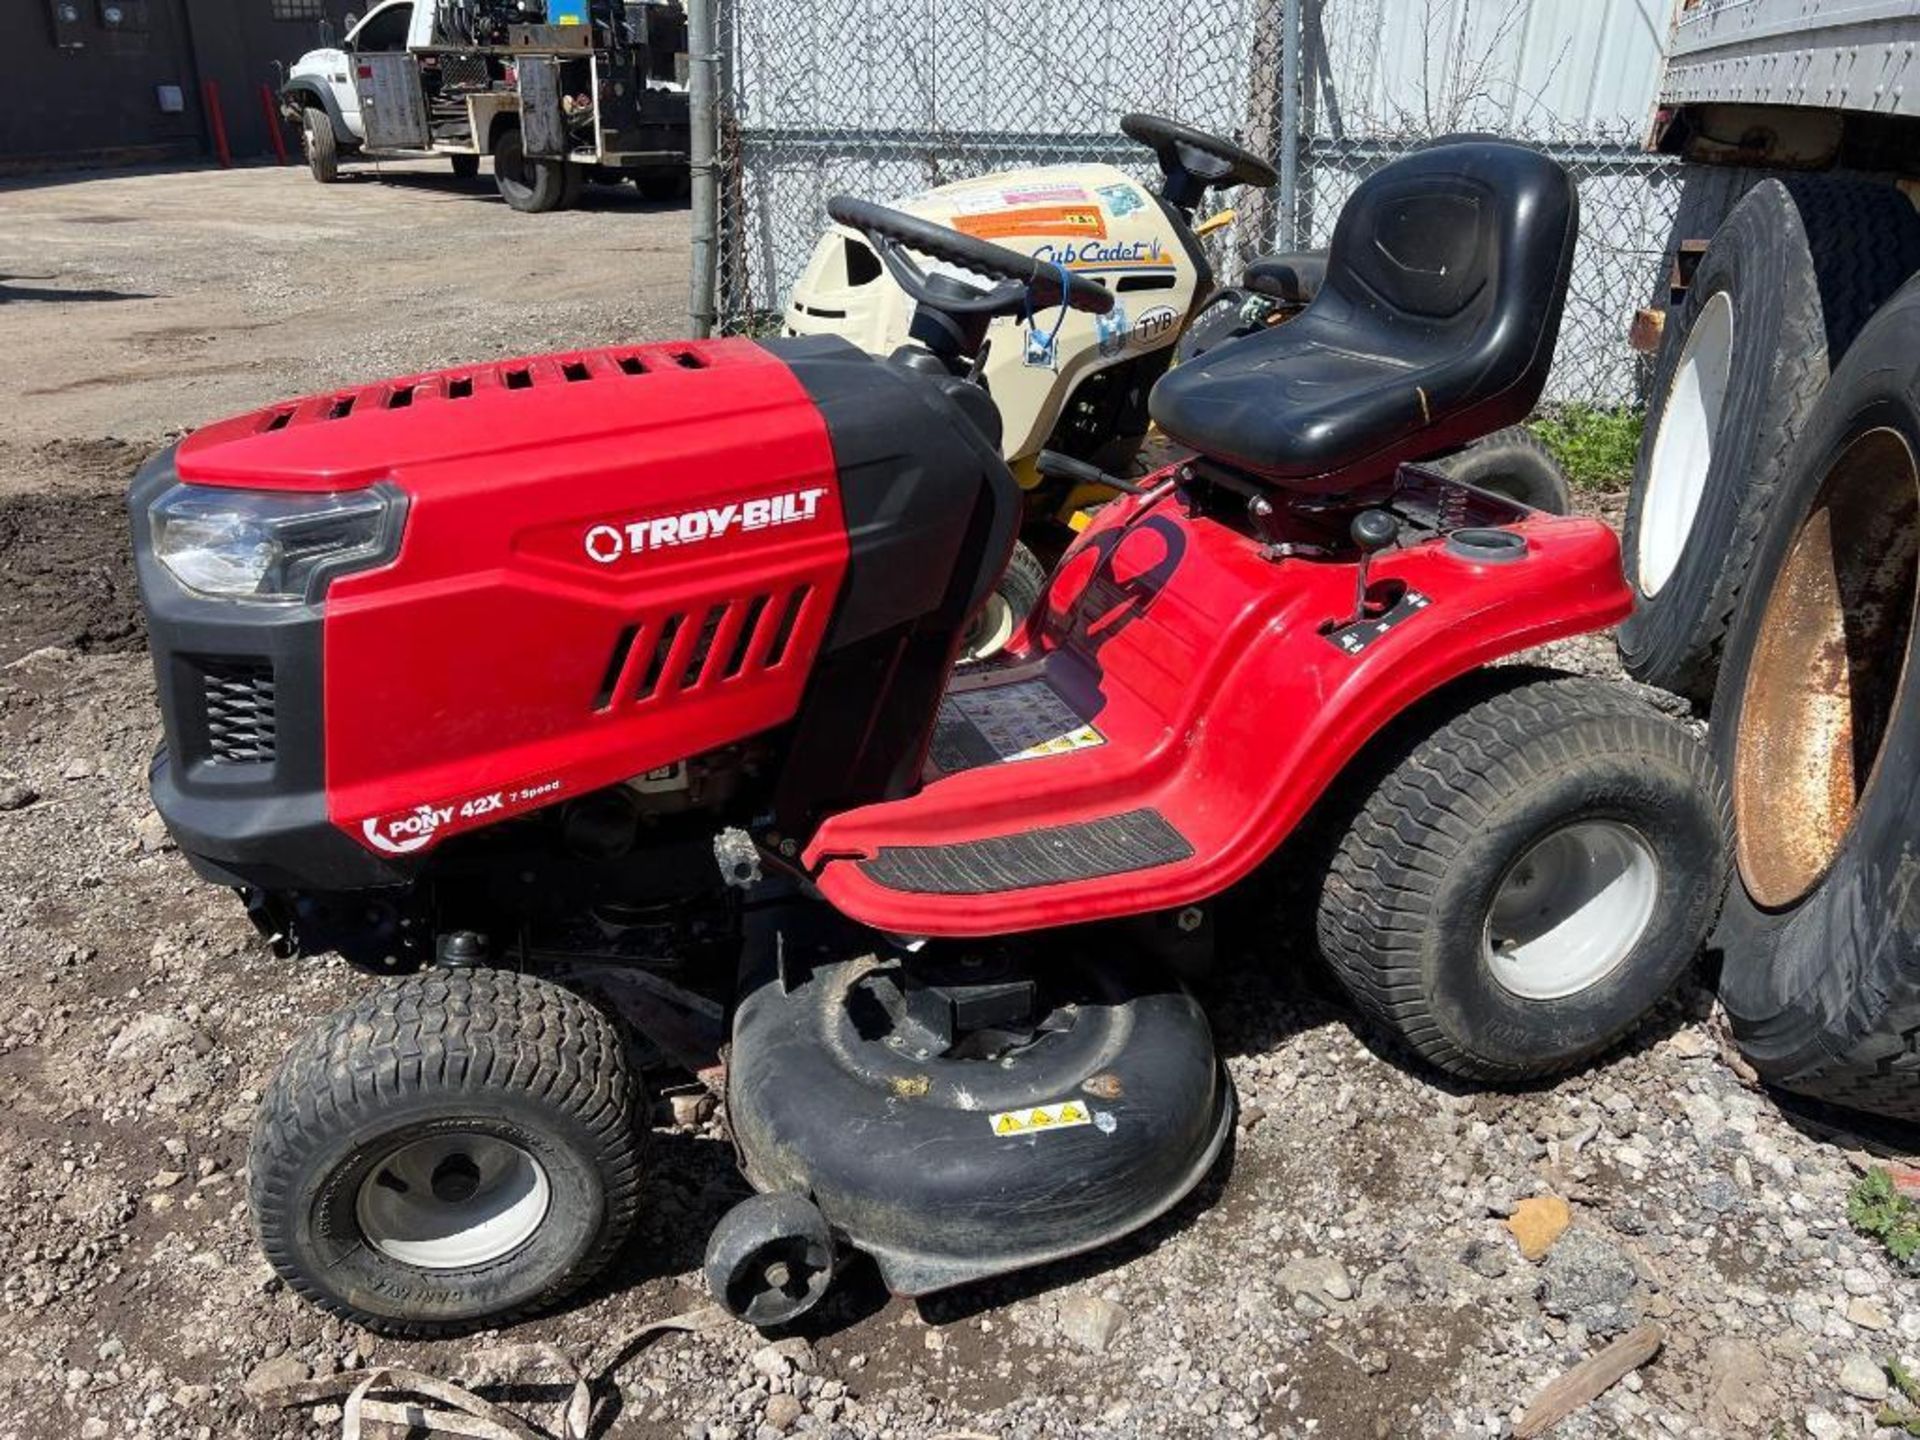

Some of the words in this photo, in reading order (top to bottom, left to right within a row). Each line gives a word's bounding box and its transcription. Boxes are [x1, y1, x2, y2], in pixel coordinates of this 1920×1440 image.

[1080, 241, 1148, 263] Cadet
[1140, 312, 1172, 338] TYB
[625, 488, 822, 553] TROY-BILT
[389, 806, 455, 837] PONY
[460, 792, 503, 817] 42X
[509, 792, 518, 802] 7
[521, 780, 560, 800] Speed
